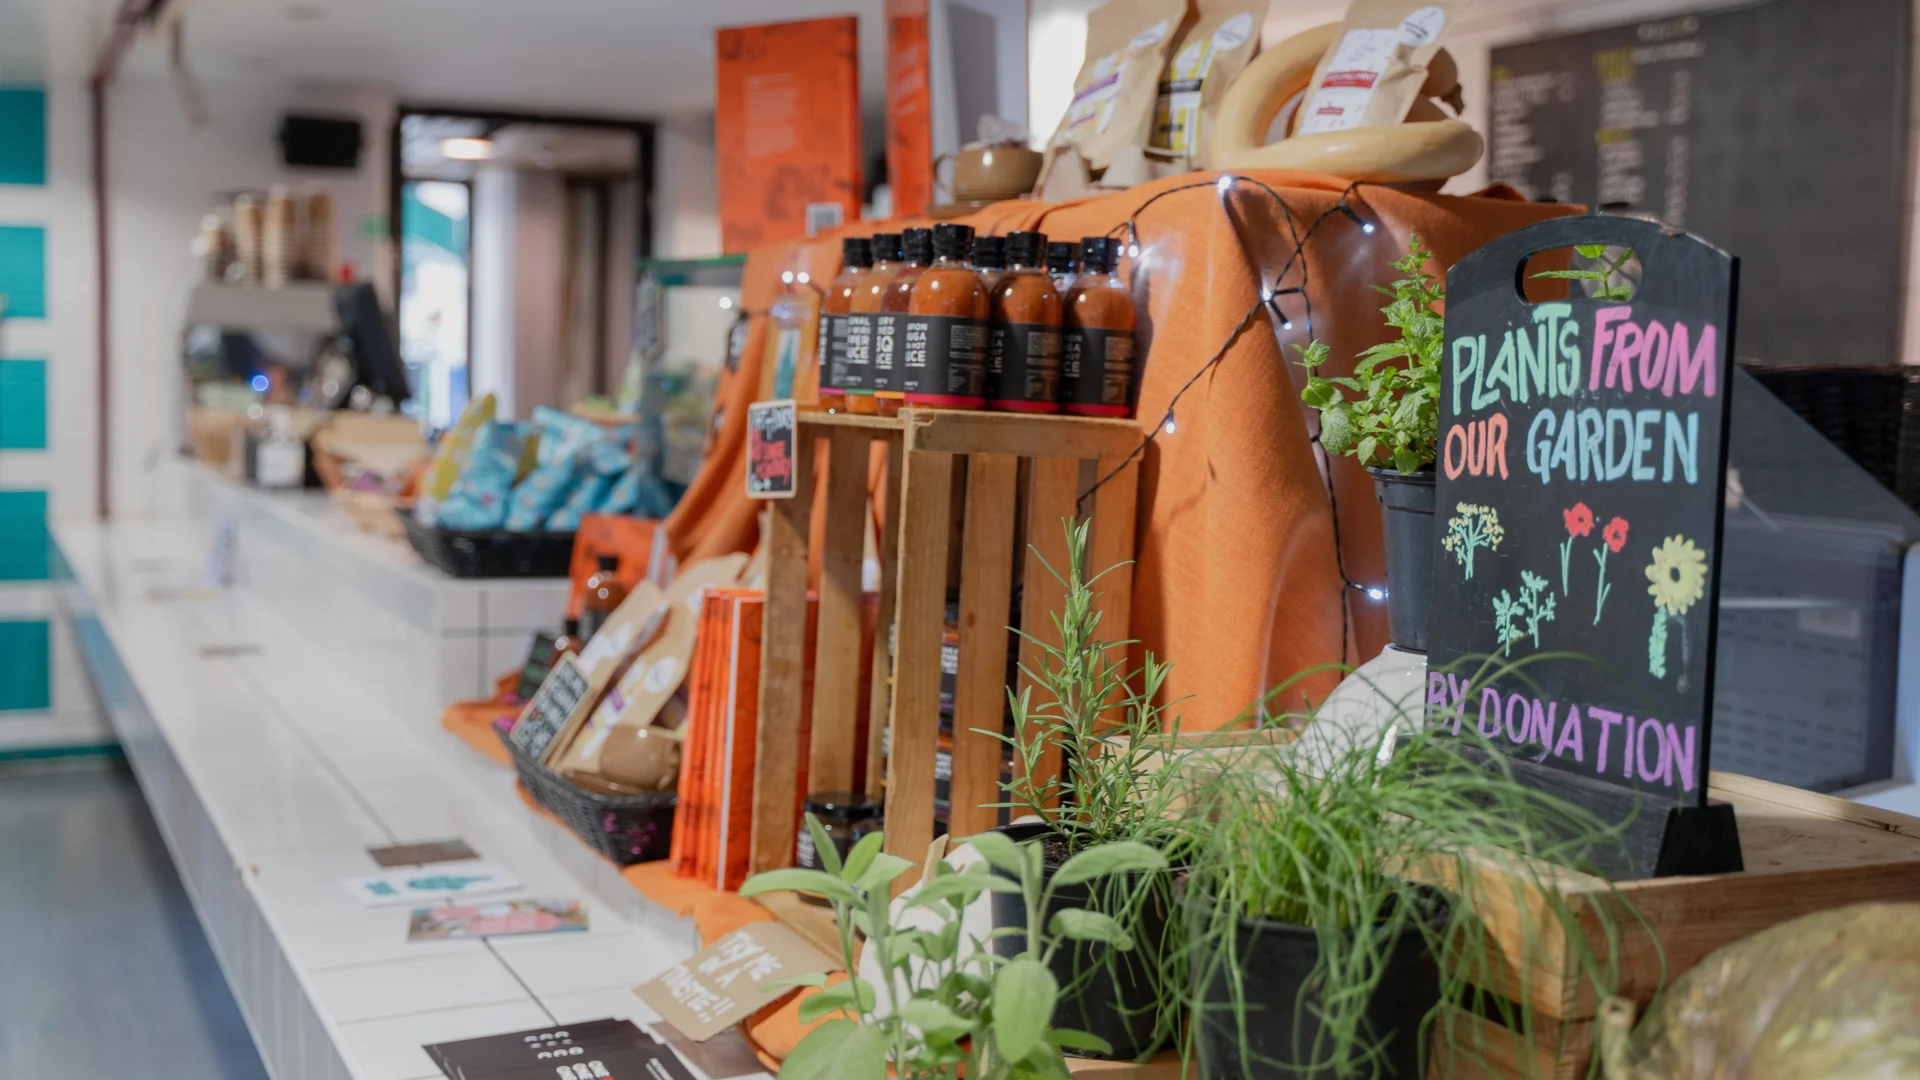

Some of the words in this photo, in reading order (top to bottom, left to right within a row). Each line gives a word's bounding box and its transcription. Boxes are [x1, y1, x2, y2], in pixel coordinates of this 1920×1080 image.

[1452, 302, 1580, 416] PLANTS
[1589, 305, 1717, 398] FROM
[1444, 413, 1509, 481] OUR
[1526, 408, 1699, 485] GARDEN
[1427, 671, 1469, 737] BY
[1477, 687, 1696, 792] DONATION
